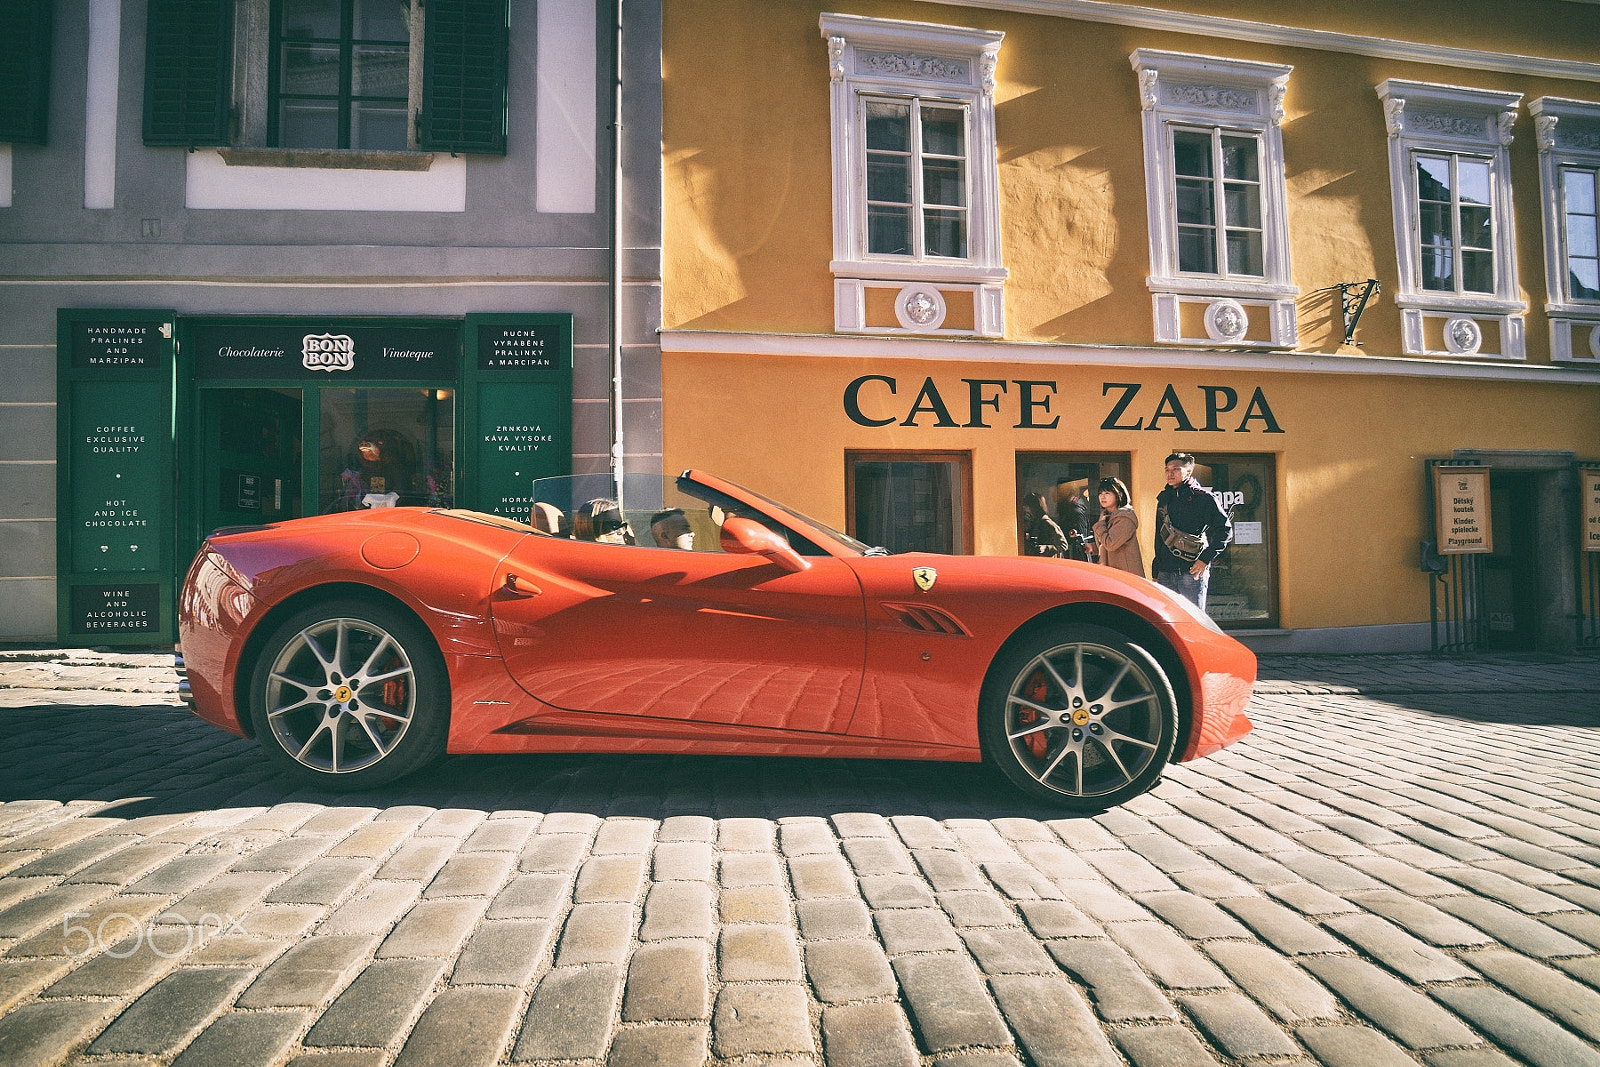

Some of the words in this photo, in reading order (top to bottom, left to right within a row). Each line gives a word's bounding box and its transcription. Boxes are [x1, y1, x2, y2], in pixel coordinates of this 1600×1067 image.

[308, 339, 348, 352] BON
[218, 346, 284, 358] Chocolaterie
[382, 347, 434, 361] Vinoteque
[308, 352, 348, 365] BON
[843, 374, 1061, 429] CAFE
[1099, 382, 1286, 434] ZAPA
[1453, 497, 1474, 506] Dětský
[1451, 526, 1479, 534] spielecke
[1448, 537, 1482, 546] Playground
[103, 590, 130, 598] WINE
[86, 610, 147, 618] ALCOHOLIC
[86, 620, 148, 629] BEVERAGES
